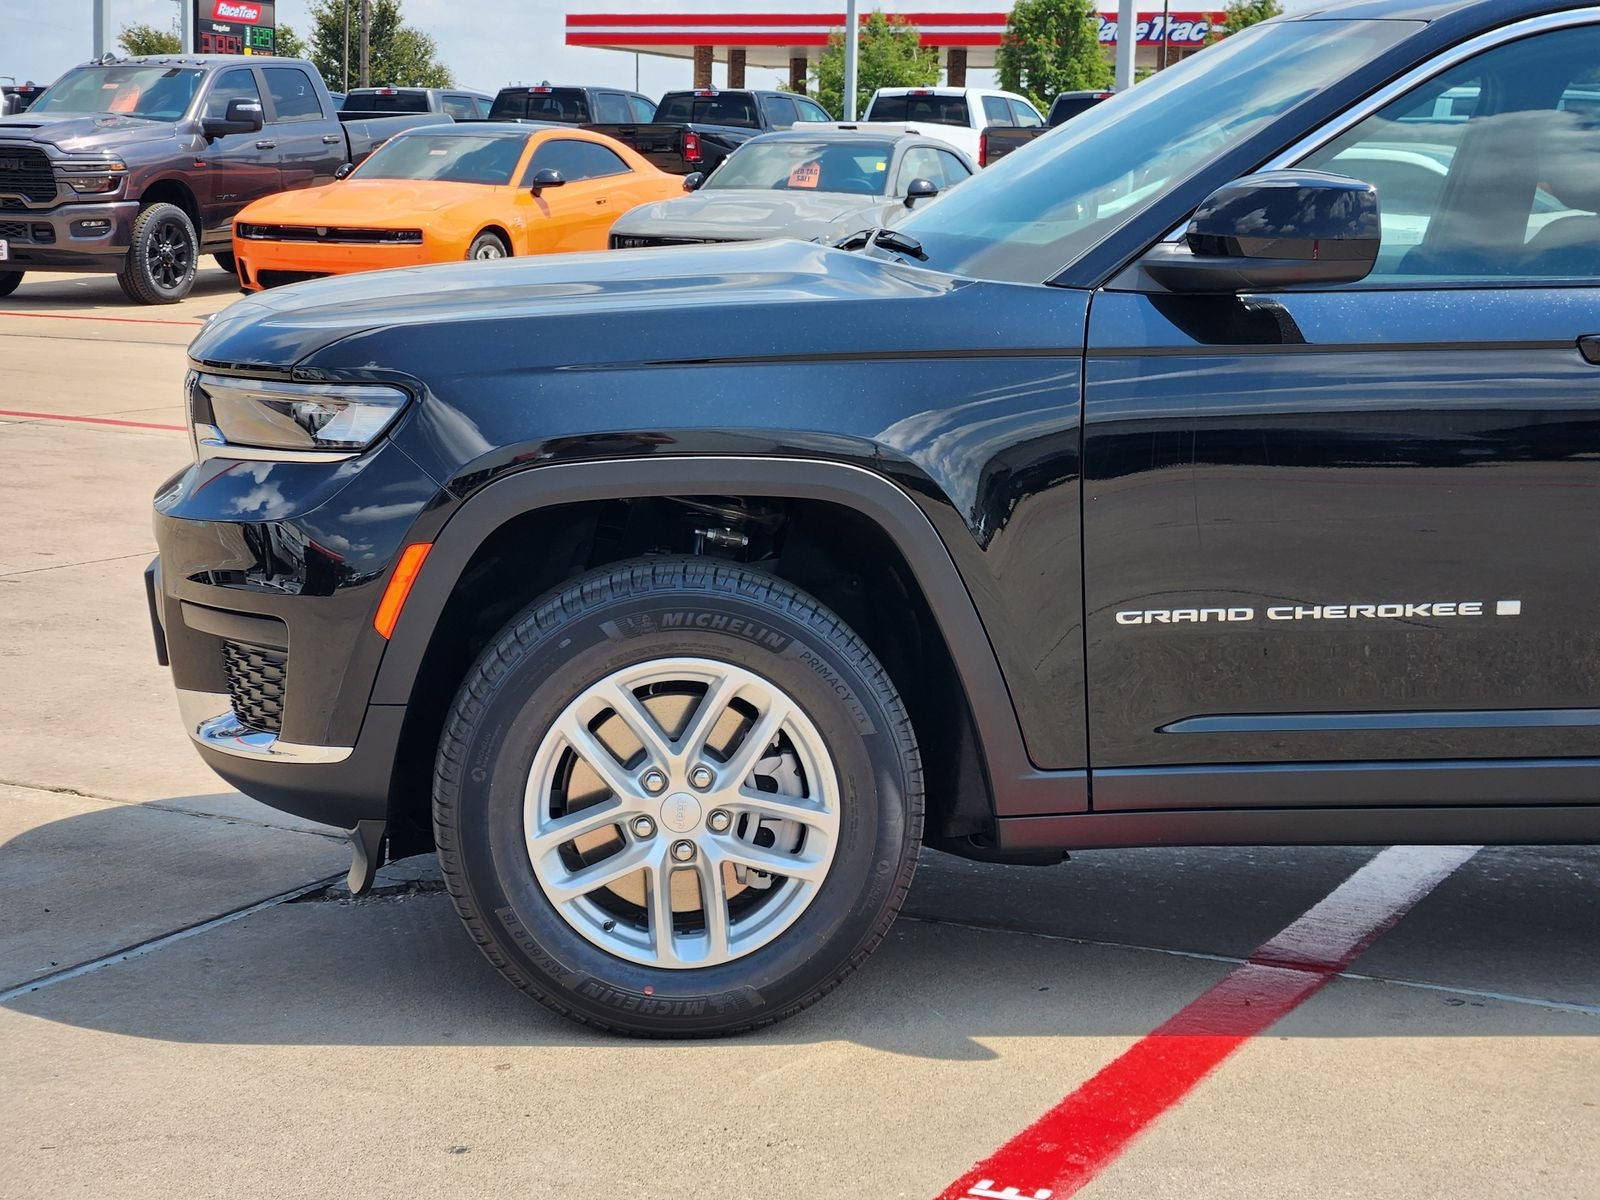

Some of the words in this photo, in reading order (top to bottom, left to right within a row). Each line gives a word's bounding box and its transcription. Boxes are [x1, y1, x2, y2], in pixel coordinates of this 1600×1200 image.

[217, 3, 258, 19] RaceTrac
[1089, 15, 1209, 42] aeTrac
[1115, 607, 1254, 625] GRAND
[1266, 601, 1483, 621] CHEROKEE
[662, 612, 786, 649] MICHELIN
[799, 651, 853, 701] PRIMACY
[583, 981, 706, 1016] MICHELIN
